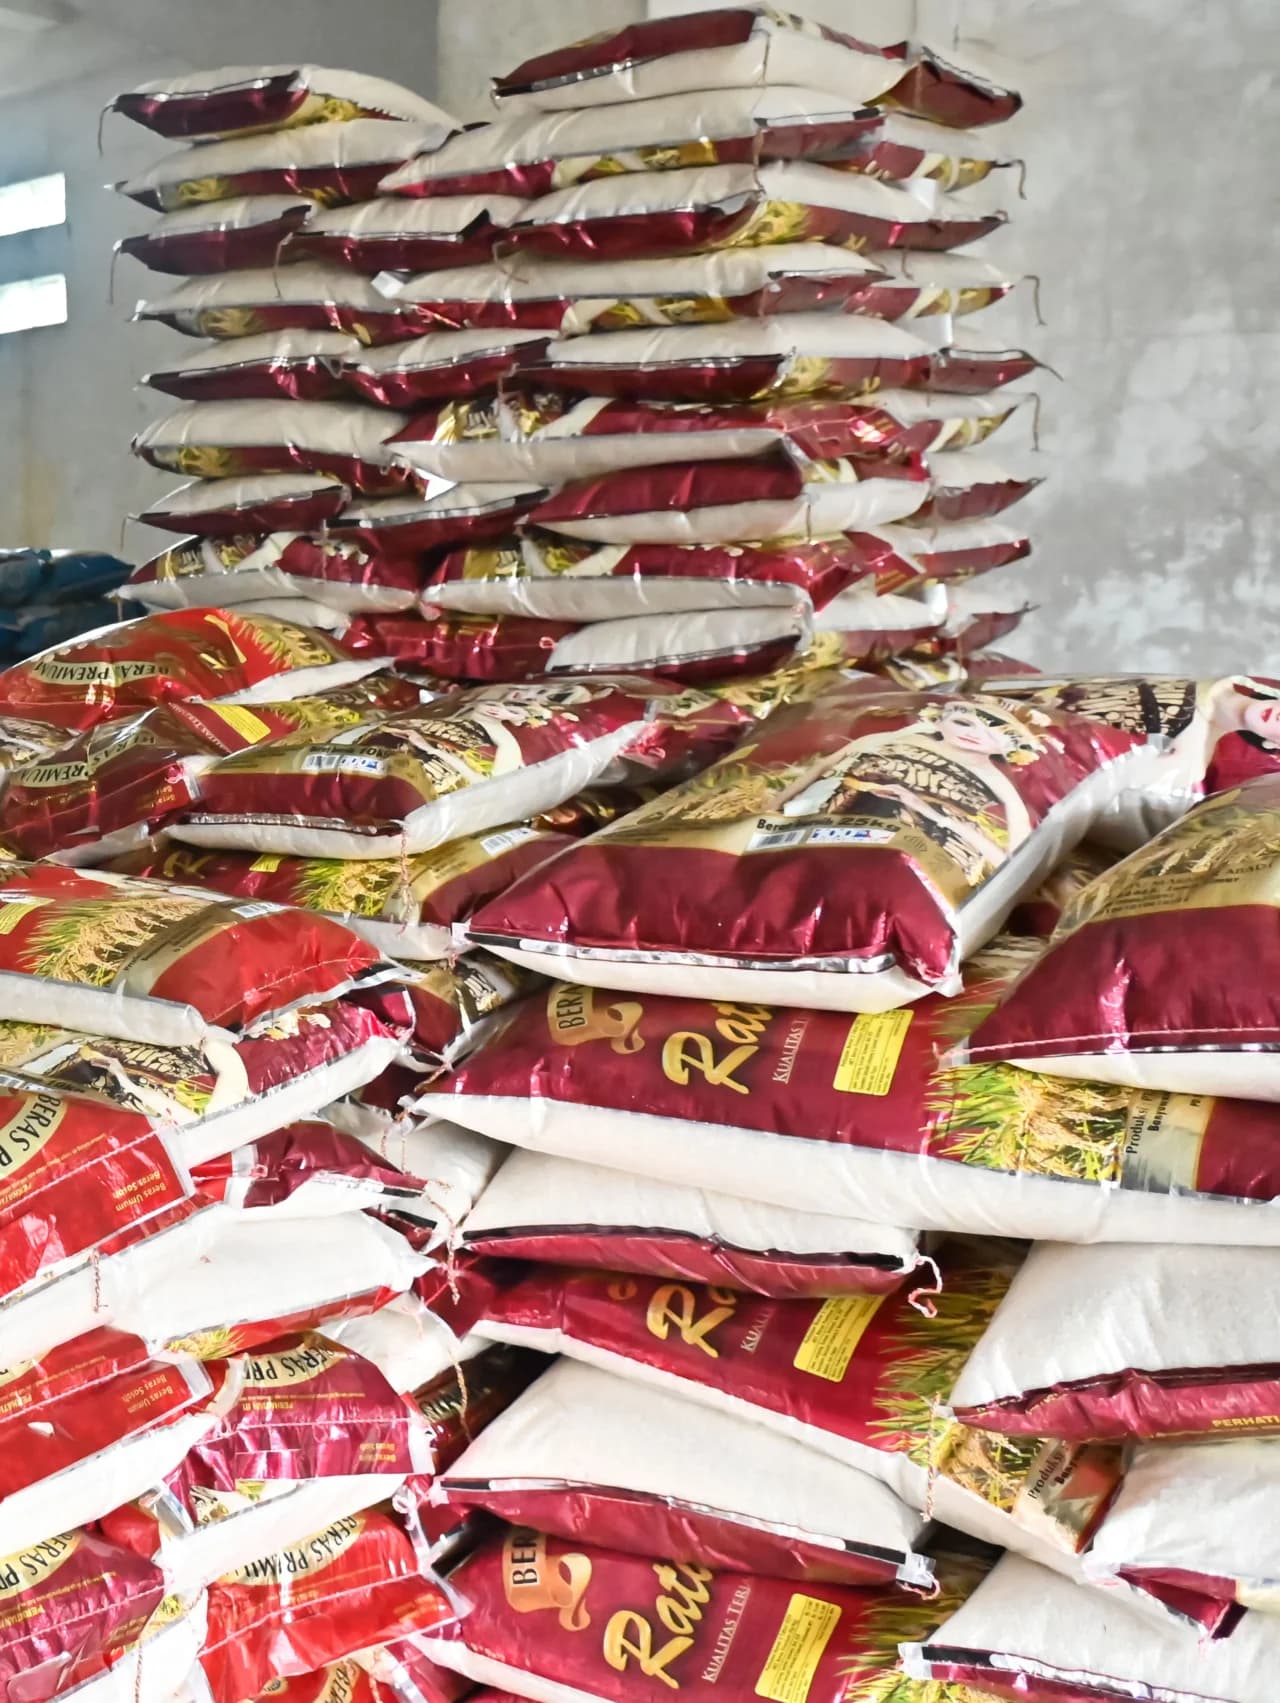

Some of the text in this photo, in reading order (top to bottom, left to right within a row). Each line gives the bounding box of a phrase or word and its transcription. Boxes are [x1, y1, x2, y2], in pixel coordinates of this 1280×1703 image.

[114, 663, 169, 679] BERA
[837, 816, 901, 833] 25kg
[9, 1094, 61, 1152] BERAS
[138, 1170, 161, 1187] Beras
[115, 1182, 167, 1212] Beras Umum
[150, 1385, 173, 1404] Beras
[701, 1617, 738, 1685] KUALITAS
